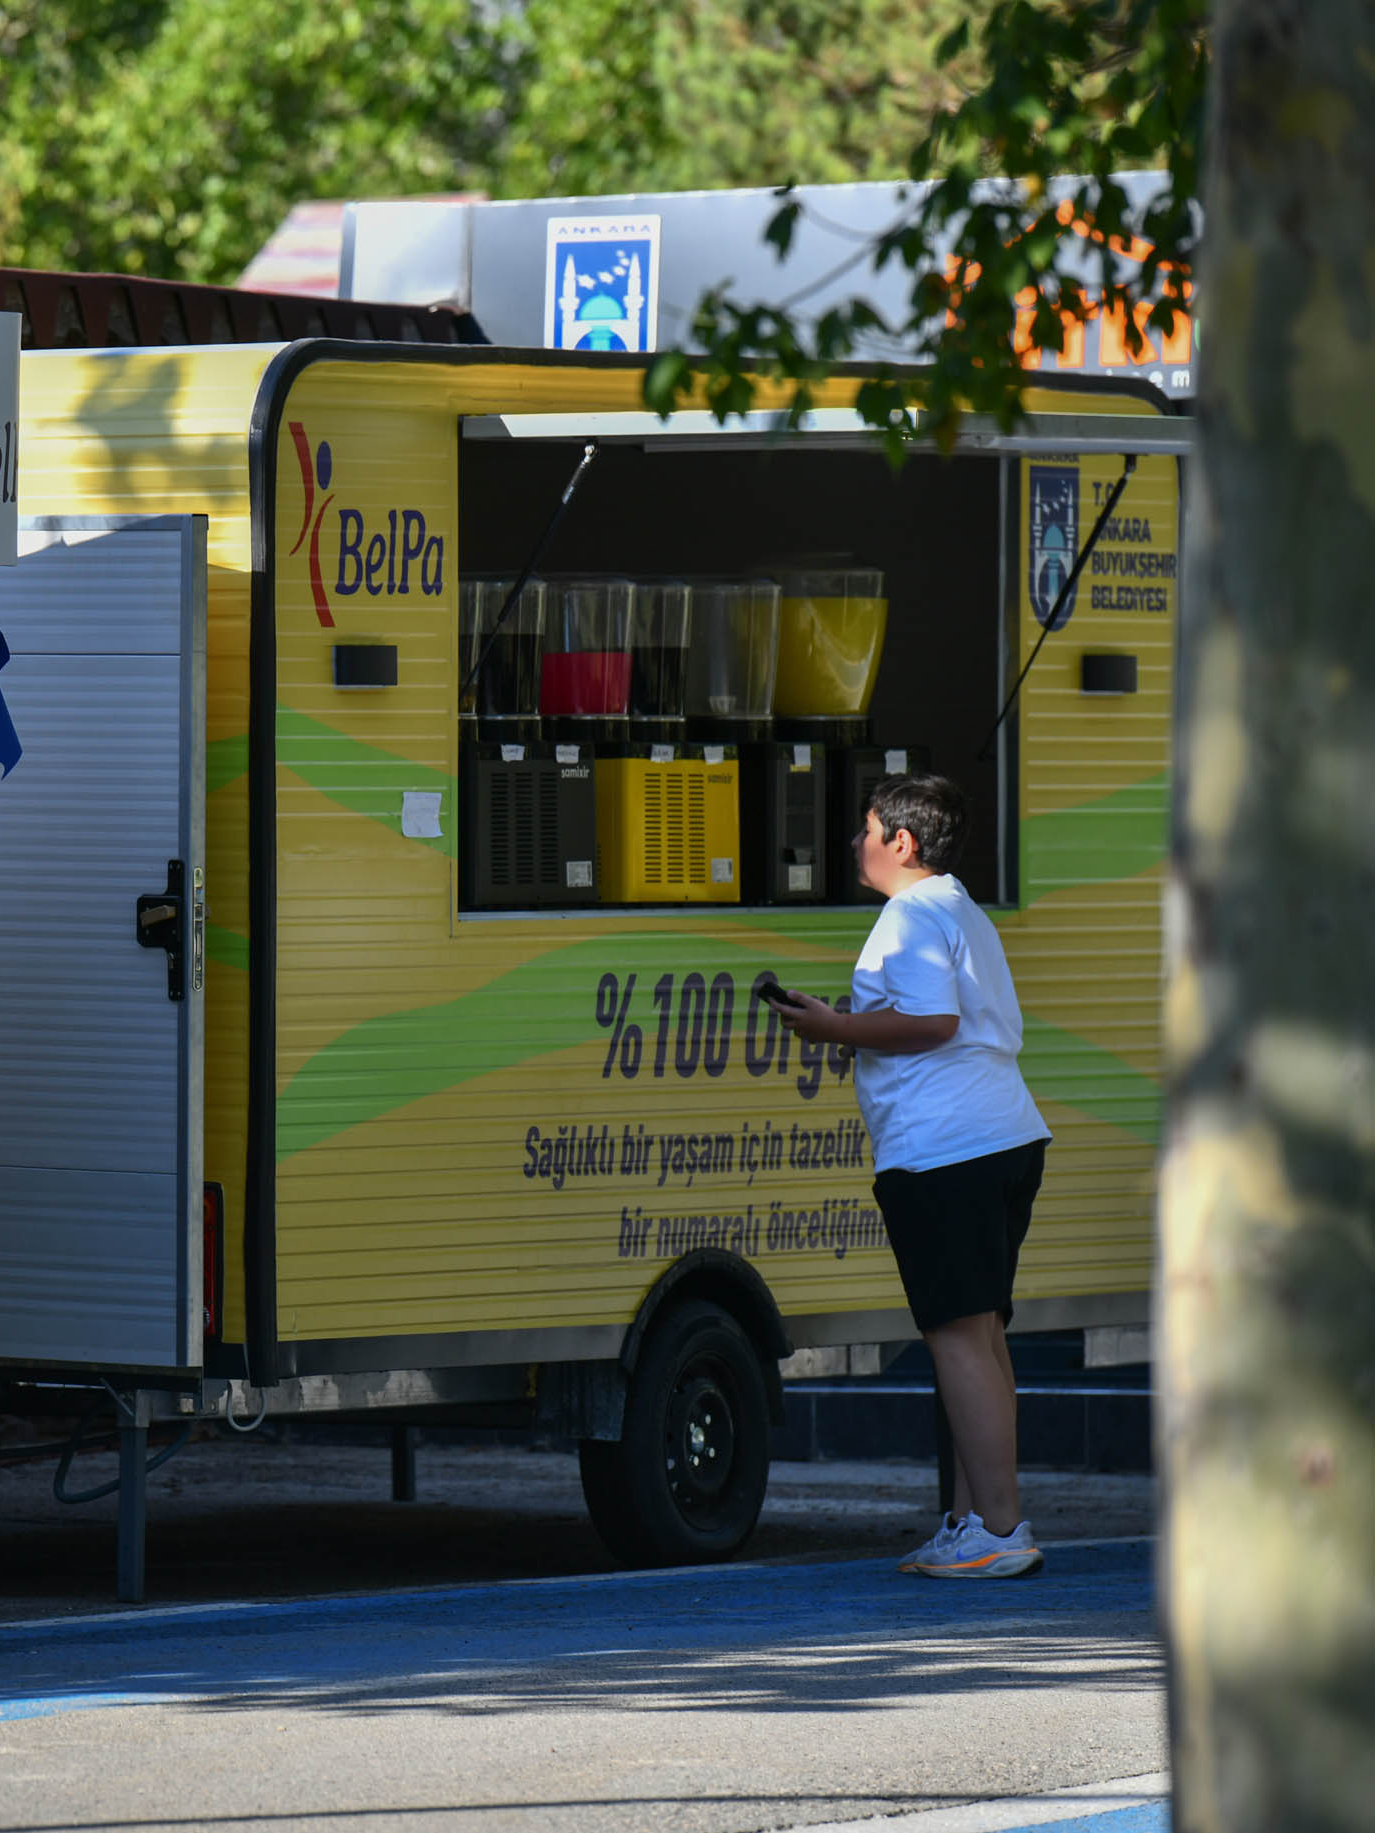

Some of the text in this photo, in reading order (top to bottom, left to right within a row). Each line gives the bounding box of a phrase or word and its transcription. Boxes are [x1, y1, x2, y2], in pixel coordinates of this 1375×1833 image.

[335, 509, 444, 597] BelPa
[524, 1119, 866, 1191] Sağlıklı bir yaşam için tazelik
[618, 1206, 655, 1258] bir
